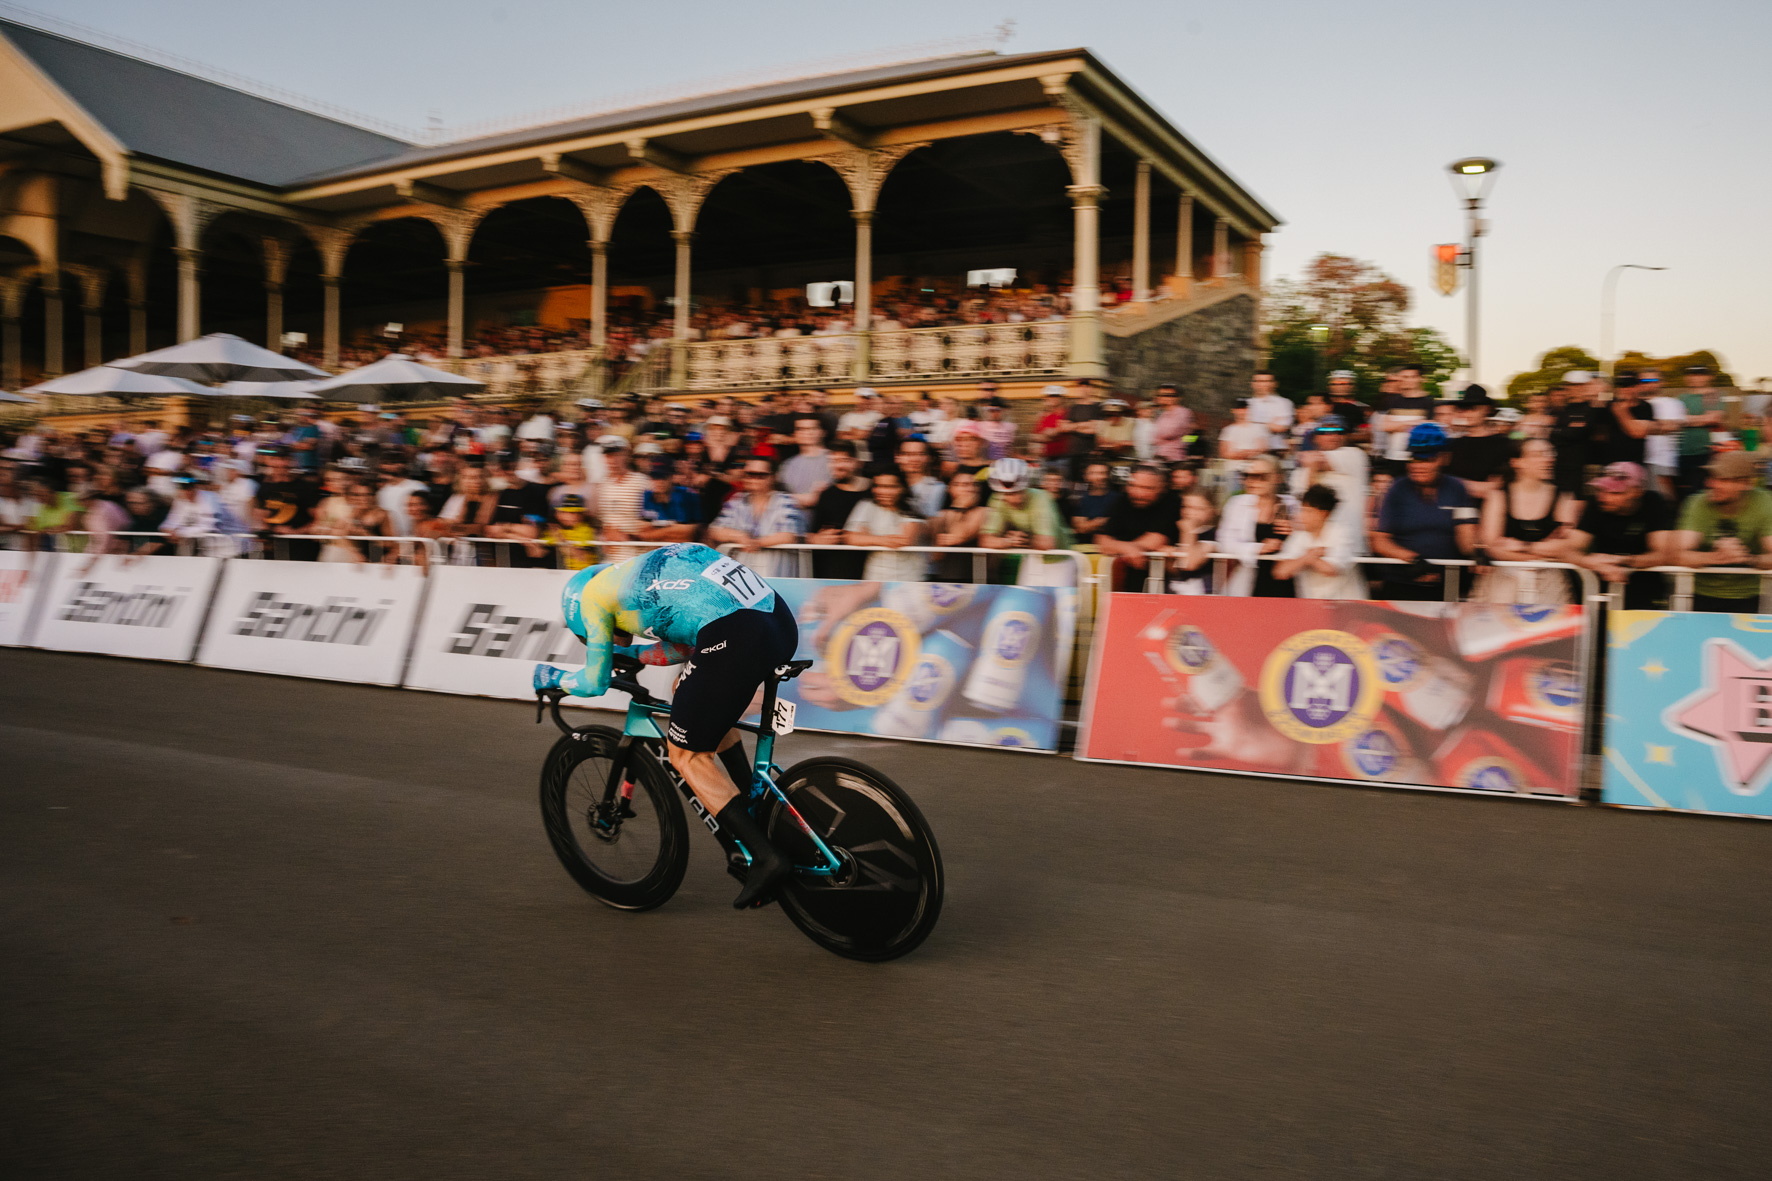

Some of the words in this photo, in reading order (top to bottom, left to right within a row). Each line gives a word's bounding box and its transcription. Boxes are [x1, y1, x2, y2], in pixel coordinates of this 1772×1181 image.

[722, 564, 764, 601] 177
[230, 591, 396, 646] Santini
[776, 701, 788, 729] 177
